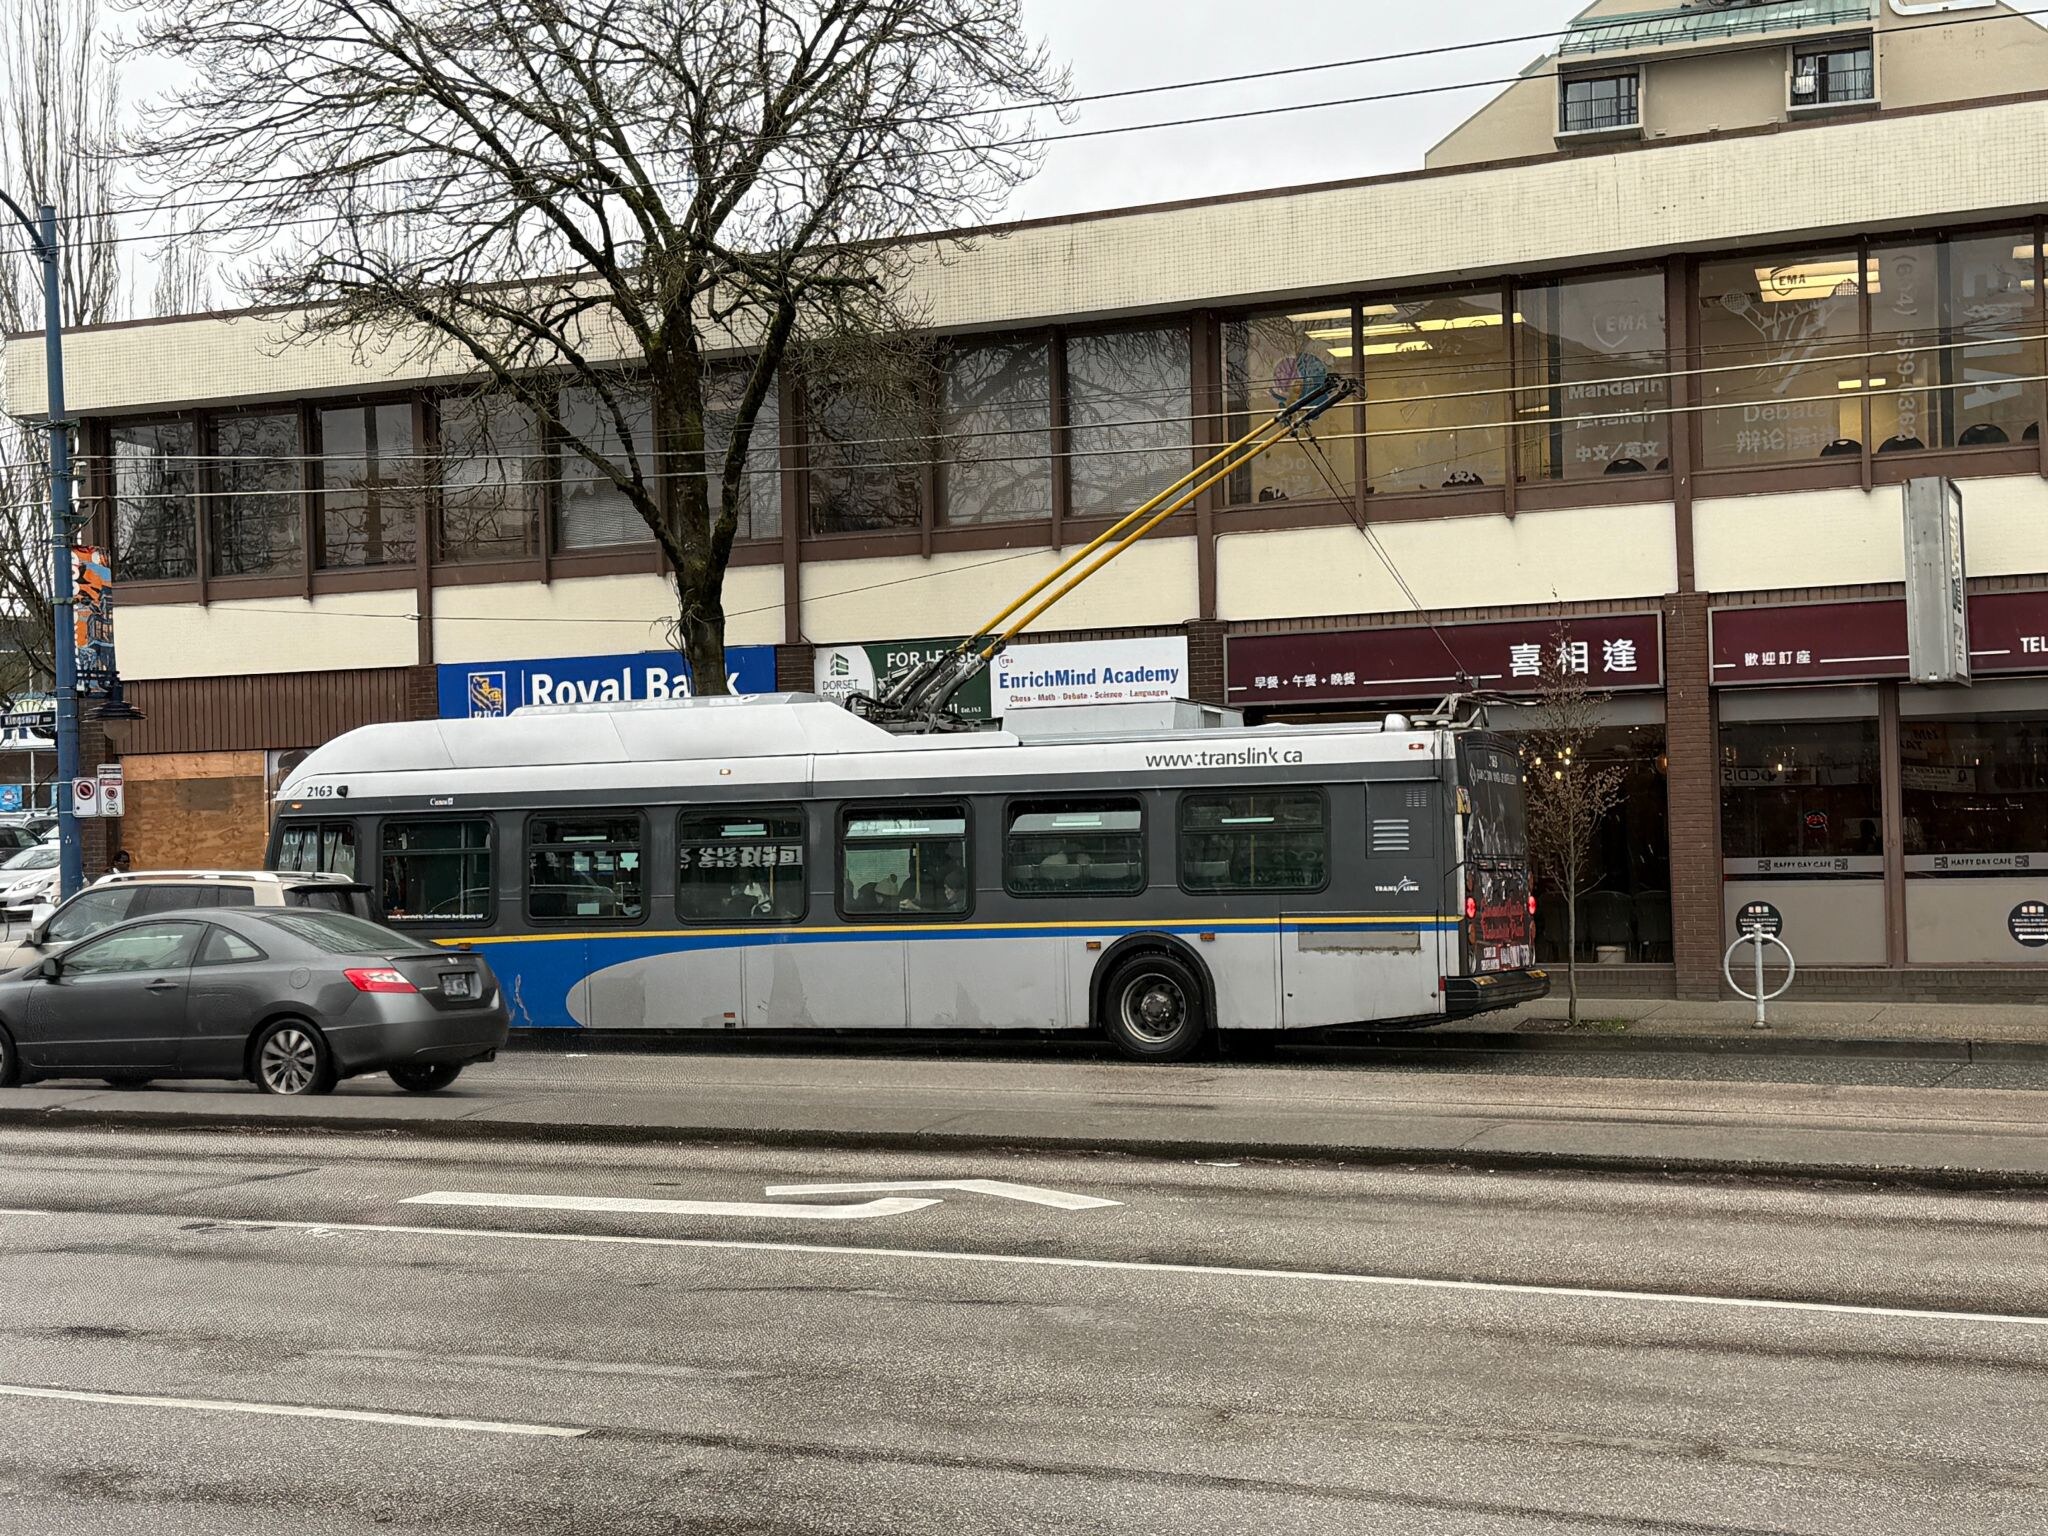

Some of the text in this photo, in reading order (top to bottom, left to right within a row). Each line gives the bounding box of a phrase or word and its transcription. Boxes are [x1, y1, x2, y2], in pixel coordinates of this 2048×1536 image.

[1779, 274, 1806, 286] EMA
[1606, 315, 1647, 332] EMA
[1568, 379, 1663, 399] Mandarin
[1744, 401, 1827, 422] Debate
[2020, 636, 2048, 653] TEL
[887, 650, 976, 668] FOR LESE
[1509, 638, 1638, 678] 喜相逢
[531, 663, 740, 705] Royal Bak
[823, 679, 858, 690] DORSET
[1000, 666, 1179, 689] EnrichMind Academy
[1145, 746, 1303, 767] www.translinkca
[307, 786, 333, 797] 2163
